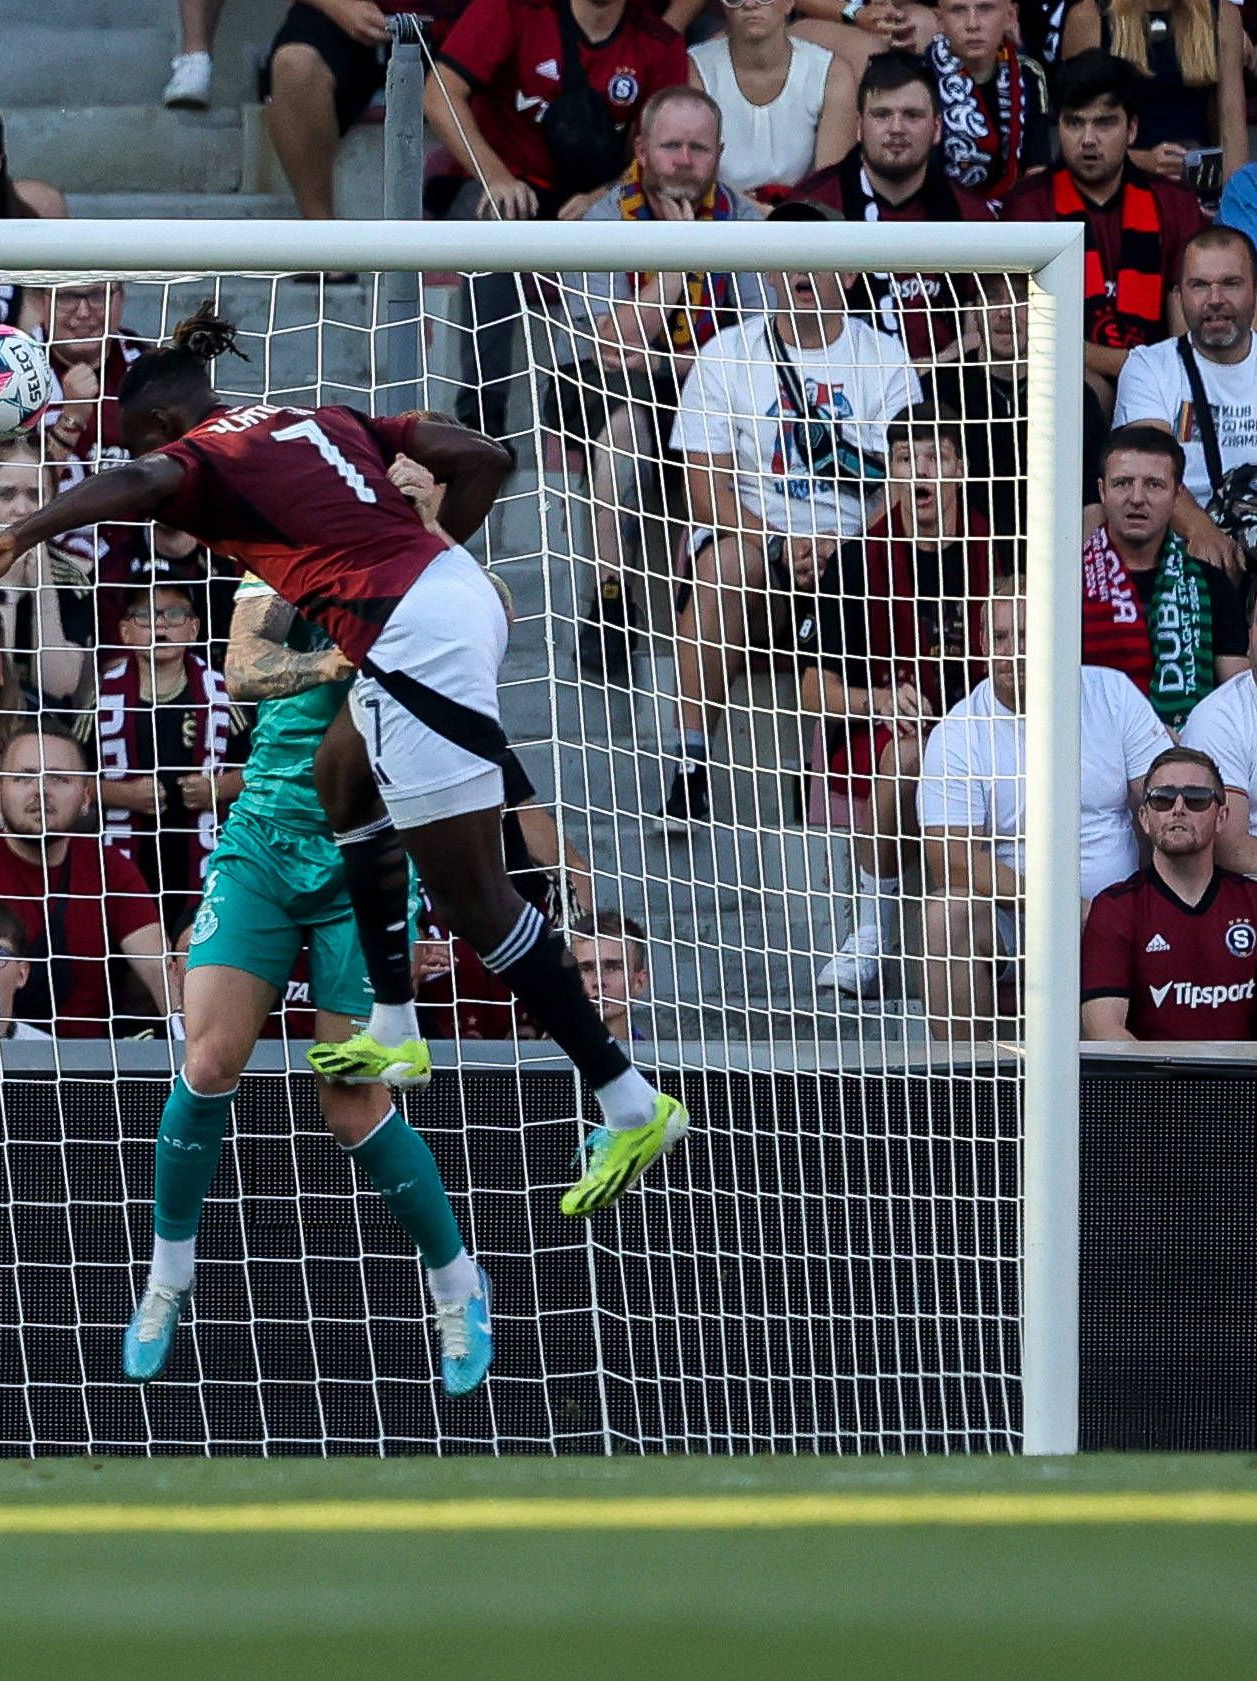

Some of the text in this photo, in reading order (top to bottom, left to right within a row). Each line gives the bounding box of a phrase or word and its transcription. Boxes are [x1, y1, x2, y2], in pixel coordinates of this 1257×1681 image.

[9, 344, 42, 403] SELECT
[270, 419, 377, 503] 7
[365, 699, 382, 757] 7
[1233, 929, 1250, 949] S
[1173, 979, 1256, 1009] Tipsport
